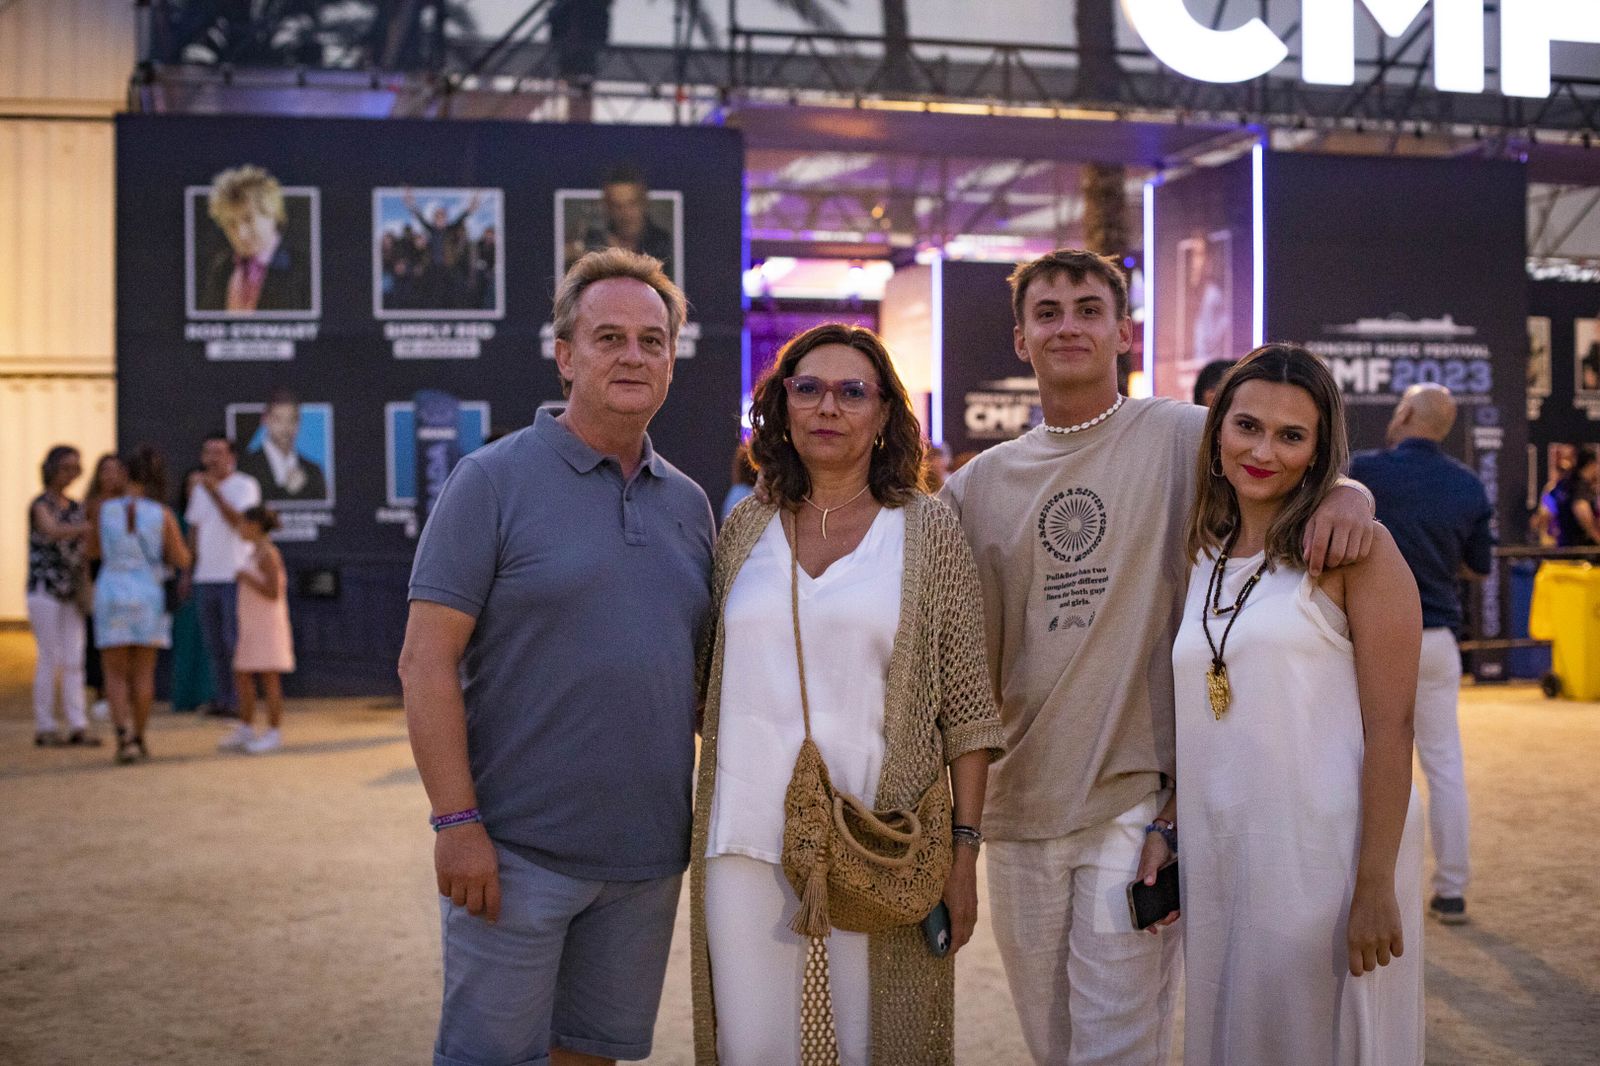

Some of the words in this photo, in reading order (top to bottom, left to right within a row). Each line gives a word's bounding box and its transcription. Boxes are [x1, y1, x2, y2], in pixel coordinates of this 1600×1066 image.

[1423, 343, 1490, 358] FESTIVAL
[1324, 357, 1492, 394] MF2023
[1077, 575, 1109, 585] different
[1070, 588, 1088, 596] both
[1089, 587, 1106, 596] guys
[1059, 600, 1071, 608] and
